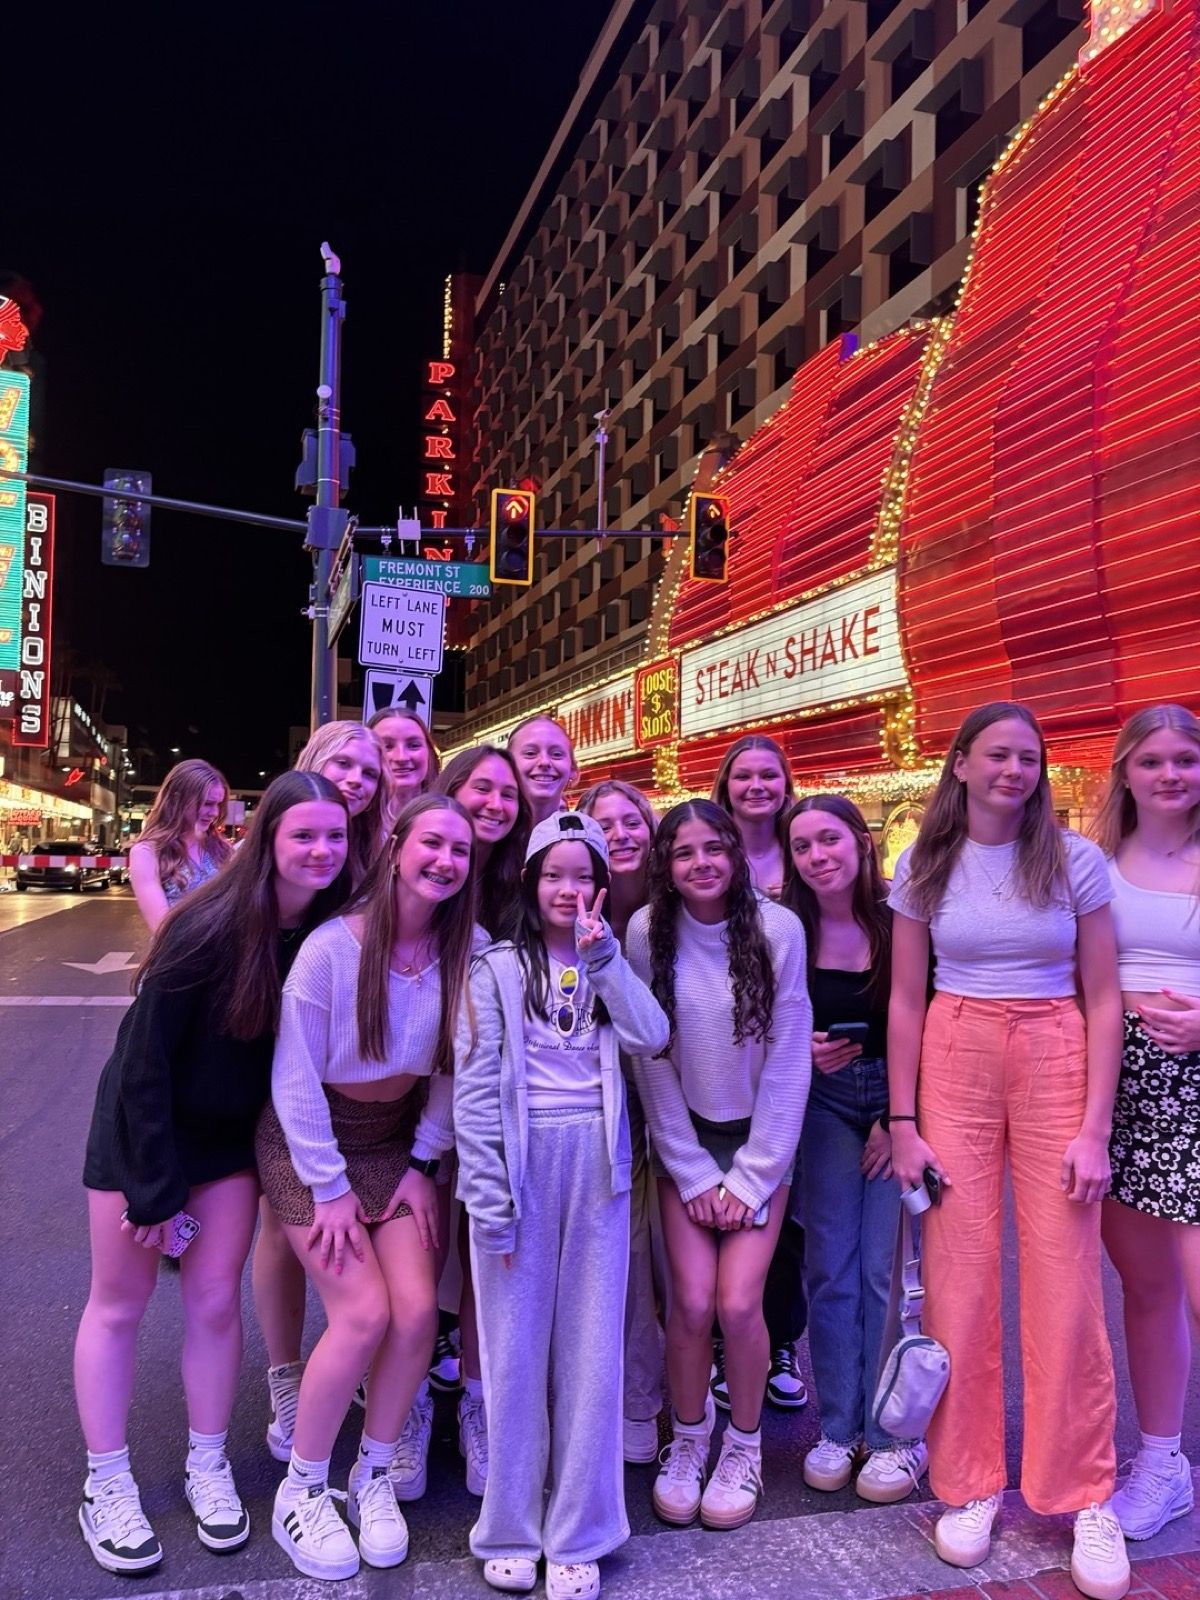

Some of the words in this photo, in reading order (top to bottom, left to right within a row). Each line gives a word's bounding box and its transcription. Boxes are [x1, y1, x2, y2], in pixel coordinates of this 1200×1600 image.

[425, 362, 456, 607] PARKIN
[379, 561, 442, 577] FREMONT
[445, 566, 460, 578] ST
[371, 594, 400, 609] LEFT
[407, 599, 438, 615] LANE
[469, 585, 490, 595] 200
[20, 503, 48, 733] BINIONS
[382, 618, 425, 638] MUST
[367, 641, 398, 656] TURN
[408, 646, 436, 661] LEFT
[696, 648, 760, 705] STEAK
[766, 650, 777, 679] N
[784, 604, 880, 679] SHAKE
[641, 667, 674, 700] LOOSE
[557, 689, 631, 748] UNKIN'
[642, 709, 671, 740] SLOTS
